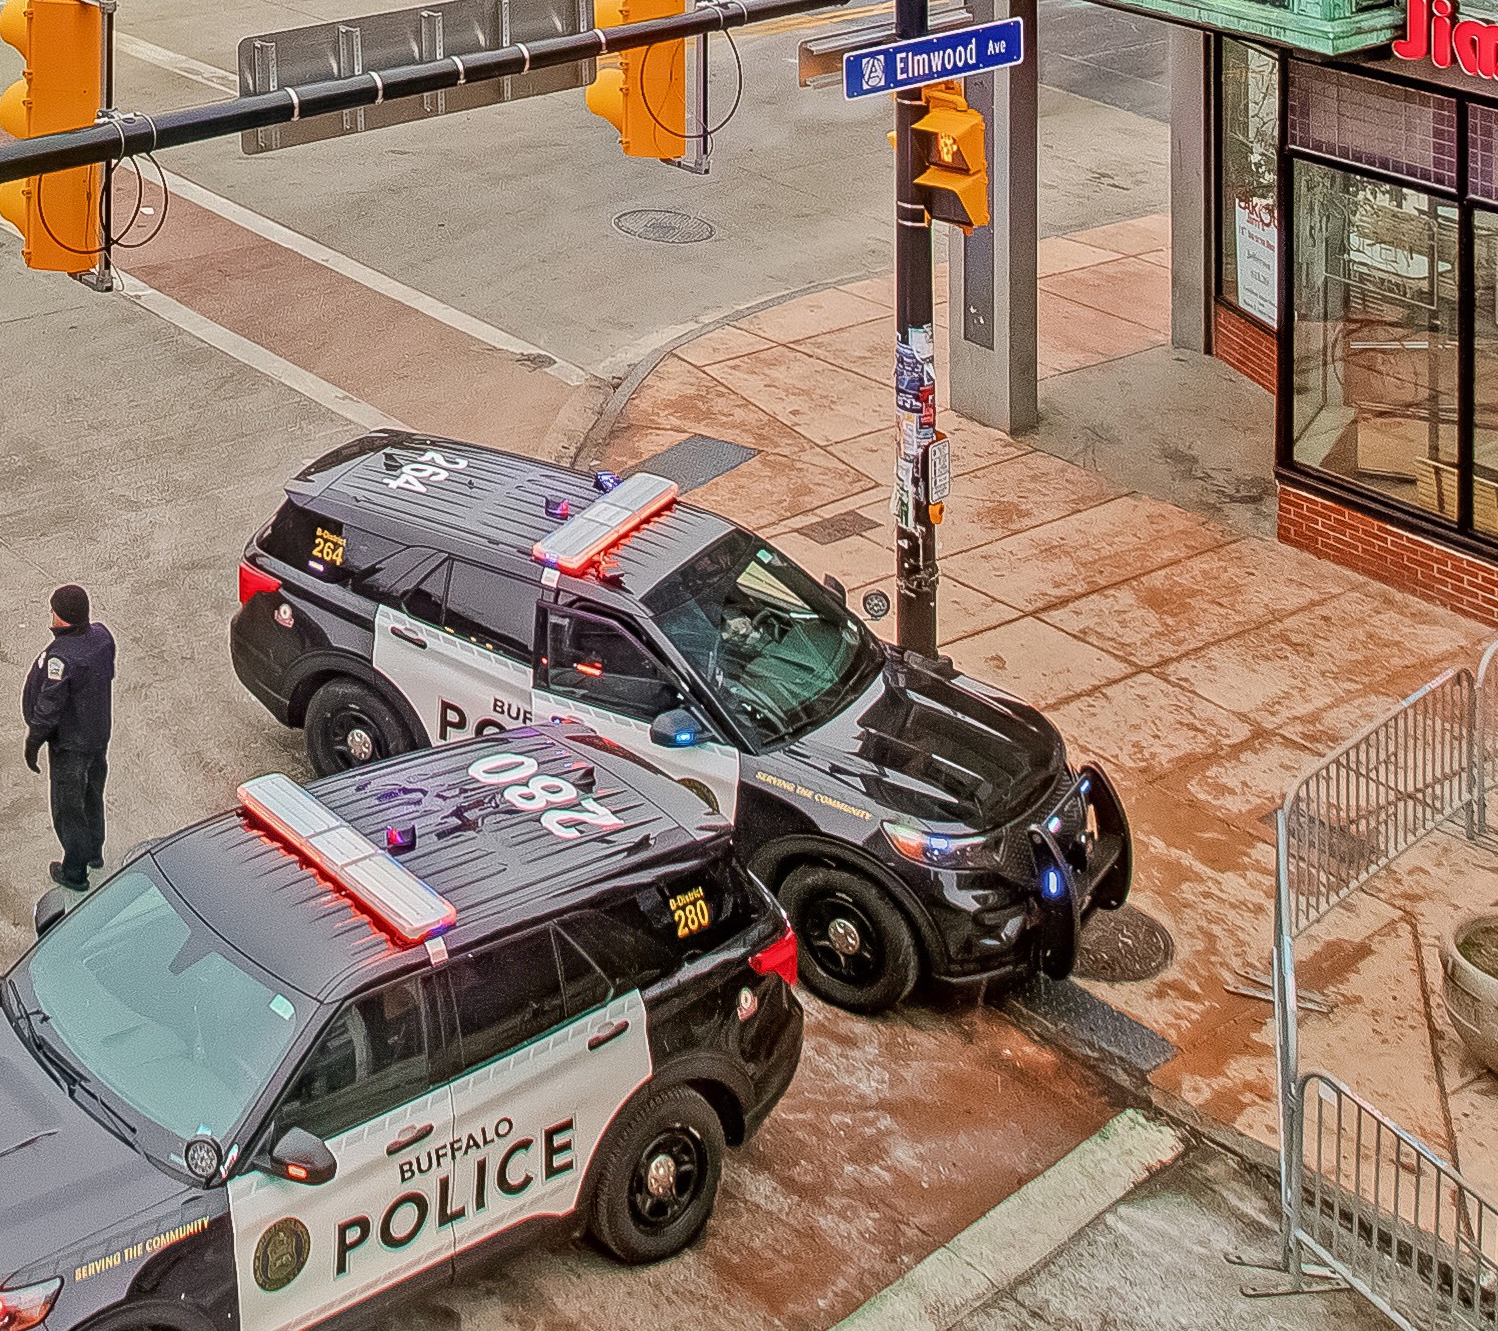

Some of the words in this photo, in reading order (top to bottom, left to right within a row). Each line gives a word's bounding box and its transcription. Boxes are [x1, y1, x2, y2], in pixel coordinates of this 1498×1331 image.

[896, 37, 977, 81] Elmwood
[987, 39, 1007, 56] Ave
[382, 448, 469, 493] 264
[311, 537, 344, 566] 264
[467, 751, 626, 840] 280
[755, 770, 796, 792] SERVING
[795, 783, 814, 799] THE
[814, 793, 872, 821] COMMUNITY
[674, 899, 710, 938] 280
[398, 1116, 514, 1184] BUFFALO
[334, 1115, 576, 1279] POLICE
[74, 1251, 121, 1282] SERVING
[123, 1242, 144, 1262] THE
[145, 1215, 210, 1253] COMMUNITY
